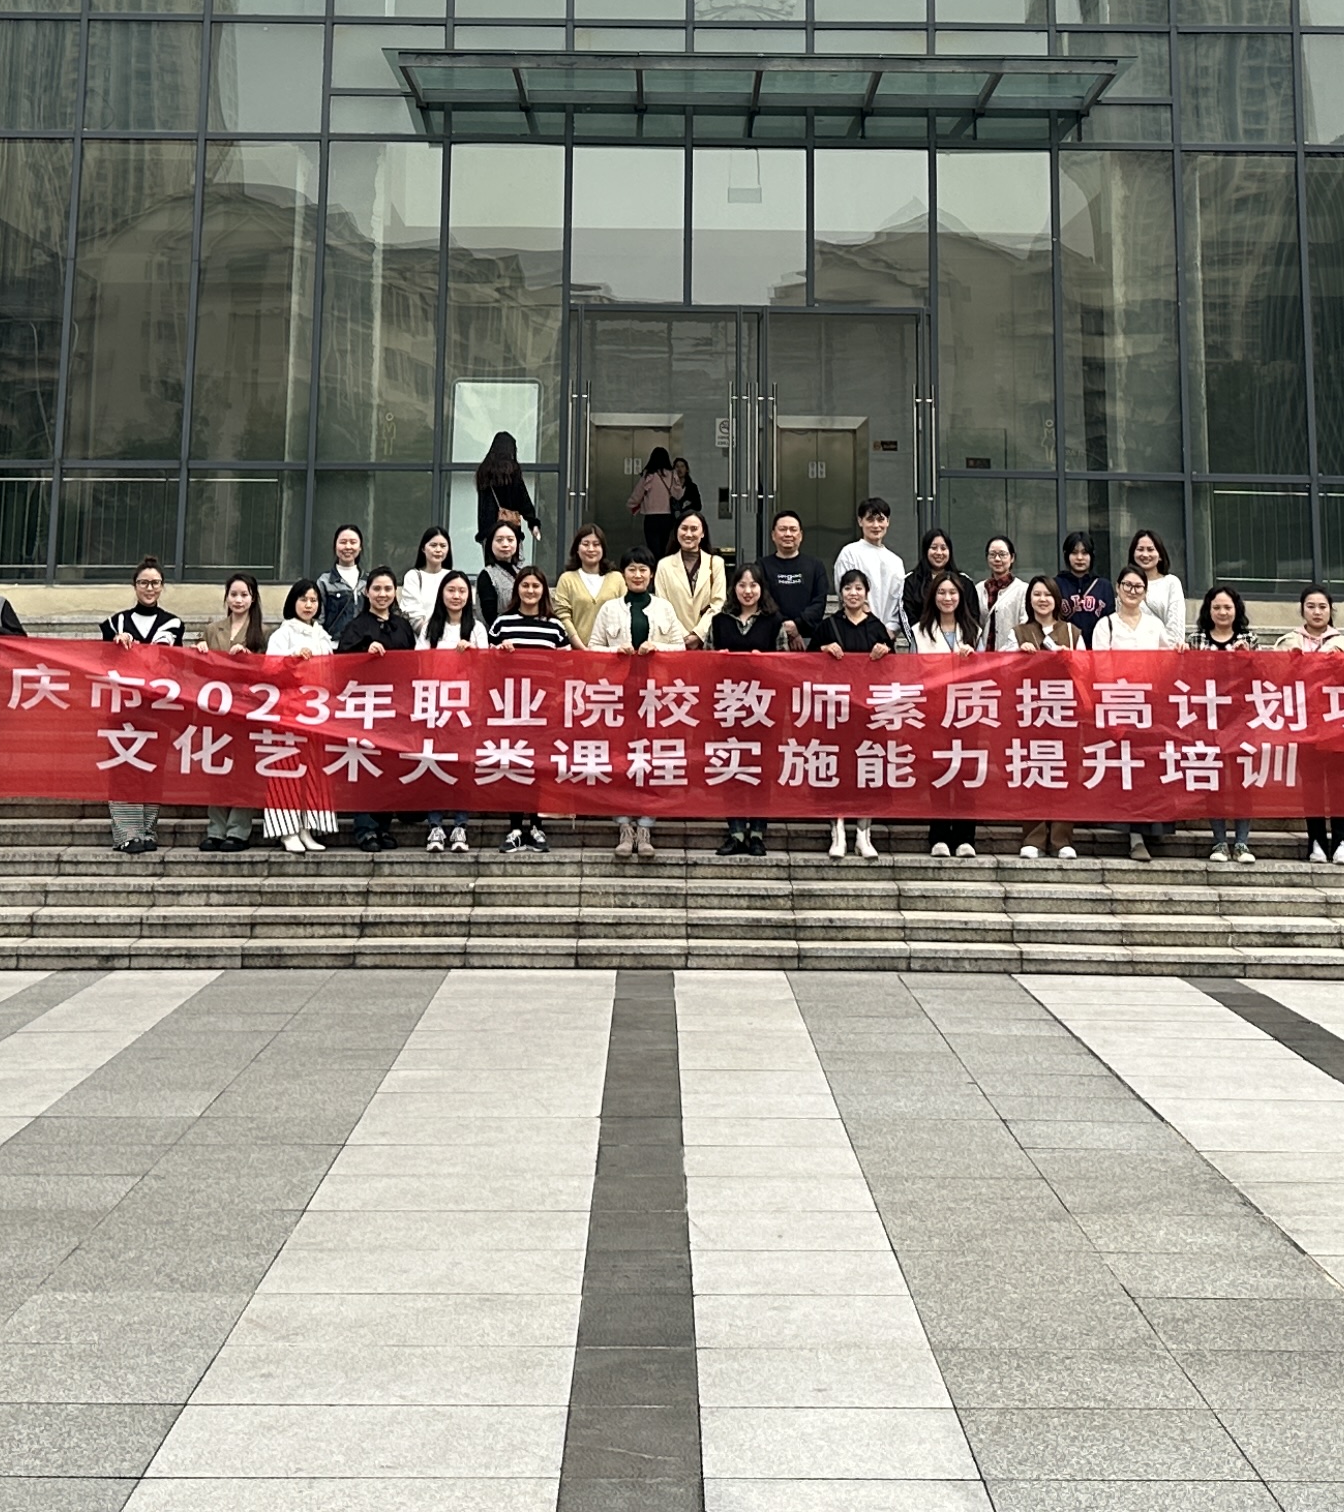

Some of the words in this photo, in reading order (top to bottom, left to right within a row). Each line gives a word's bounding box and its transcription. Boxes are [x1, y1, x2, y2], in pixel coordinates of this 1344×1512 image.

[95, 721, 1299, 792] 文化艺术大类课程实施能力提升培训
